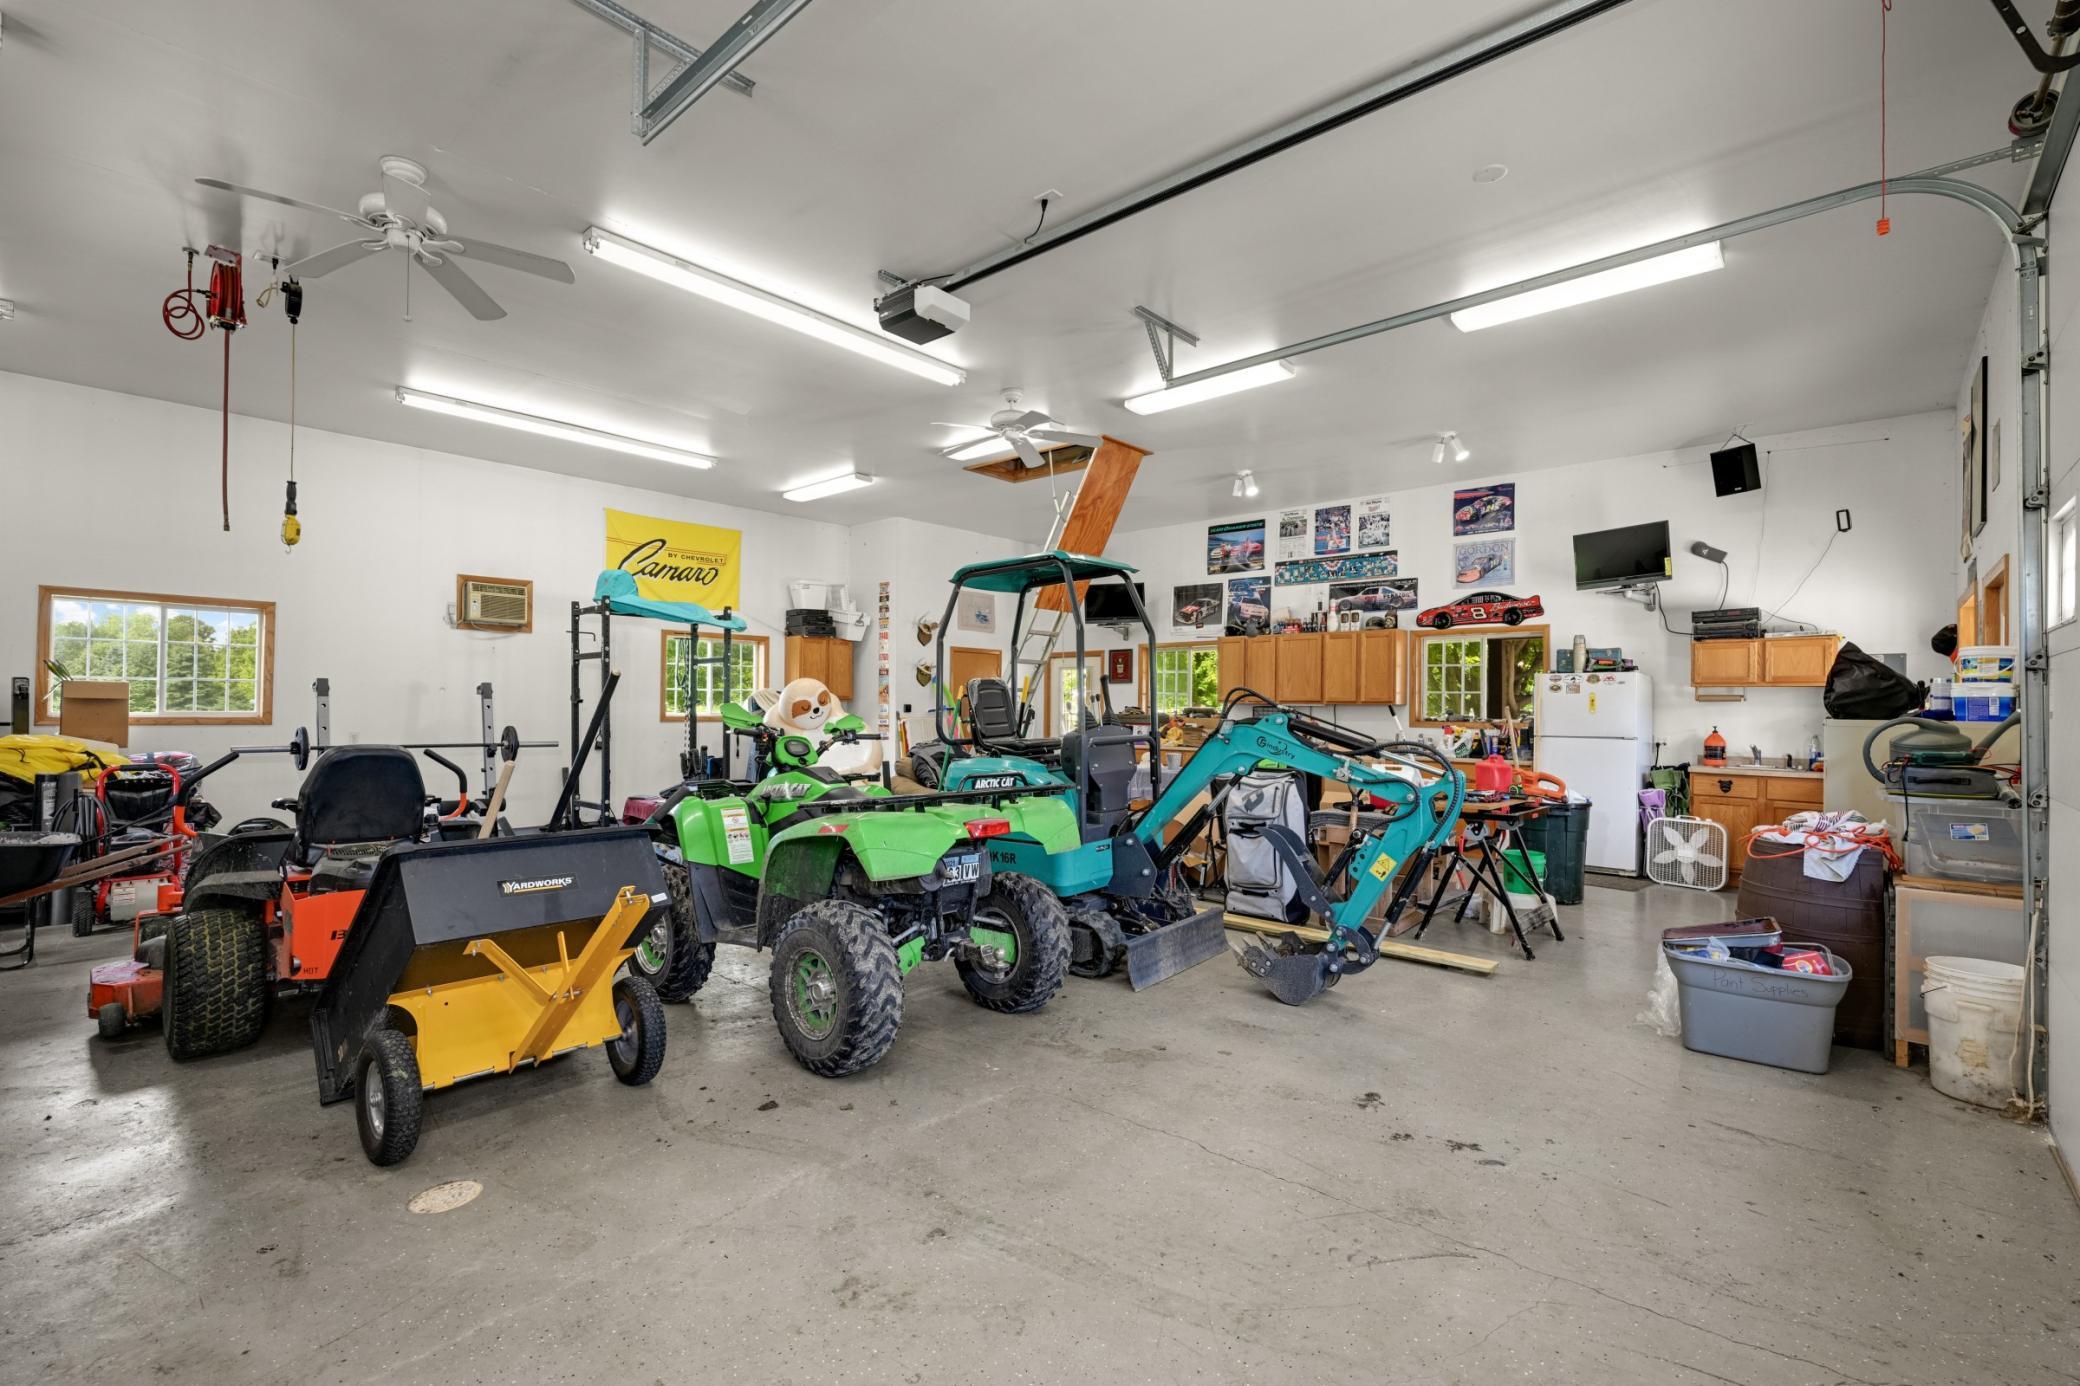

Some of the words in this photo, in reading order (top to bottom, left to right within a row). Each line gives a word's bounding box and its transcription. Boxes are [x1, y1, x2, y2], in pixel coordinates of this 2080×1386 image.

[1460, 543, 1509, 556] GORDON
[617, 538, 719, 585] Camaro
[681, 554, 724, 564] CHEVROLET
[1470, 607, 1486, 620] 8
[975, 778, 1000, 790] ARCTIC
[1001, 776, 1014, 788] CAT
[789, 783, 812, 798] CAT
[503, 877, 573, 894] YARDWORKS
[303, 967, 319, 975] HOT
